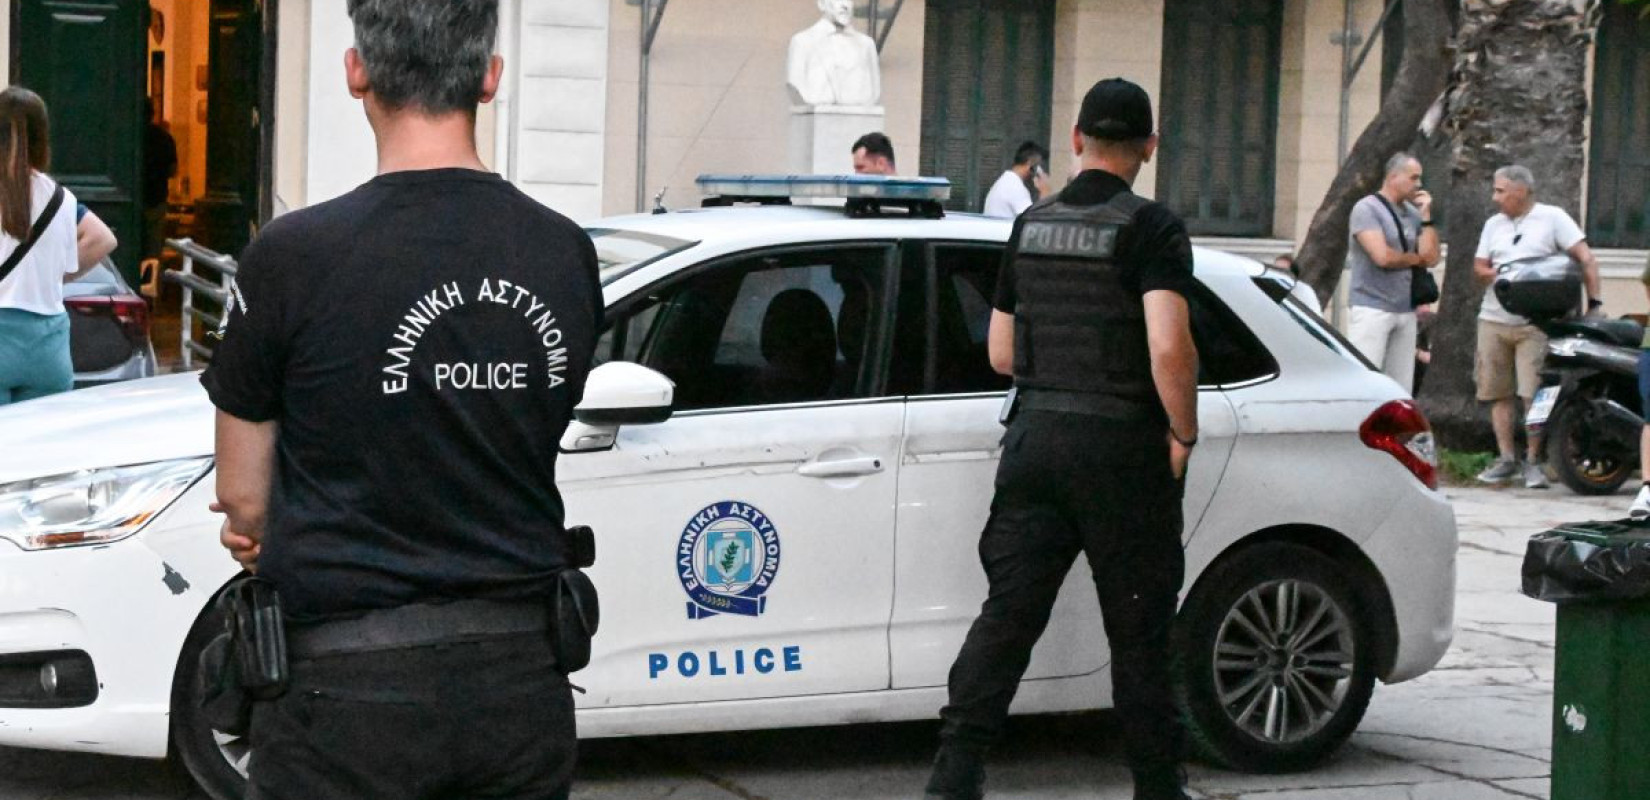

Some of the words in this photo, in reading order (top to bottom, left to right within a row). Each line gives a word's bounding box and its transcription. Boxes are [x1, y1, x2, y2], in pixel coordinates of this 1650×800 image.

[1021, 224, 1112, 253] POLICE
[382, 281, 464, 394] ΕΛΛΗΝΙΚΗ
[478, 278, 568, 388] ΑΣΤΥΝΟΜΙΑ
[435, 362, 528, 390] POLICE
[680, 506, 720, 590] ΕΛΛΗΝΙΚΗ
[729, 502, 778, 587] ΑΣΤΥΝΟΜΙΑ
[649, 646, 802, 679] POLICE
